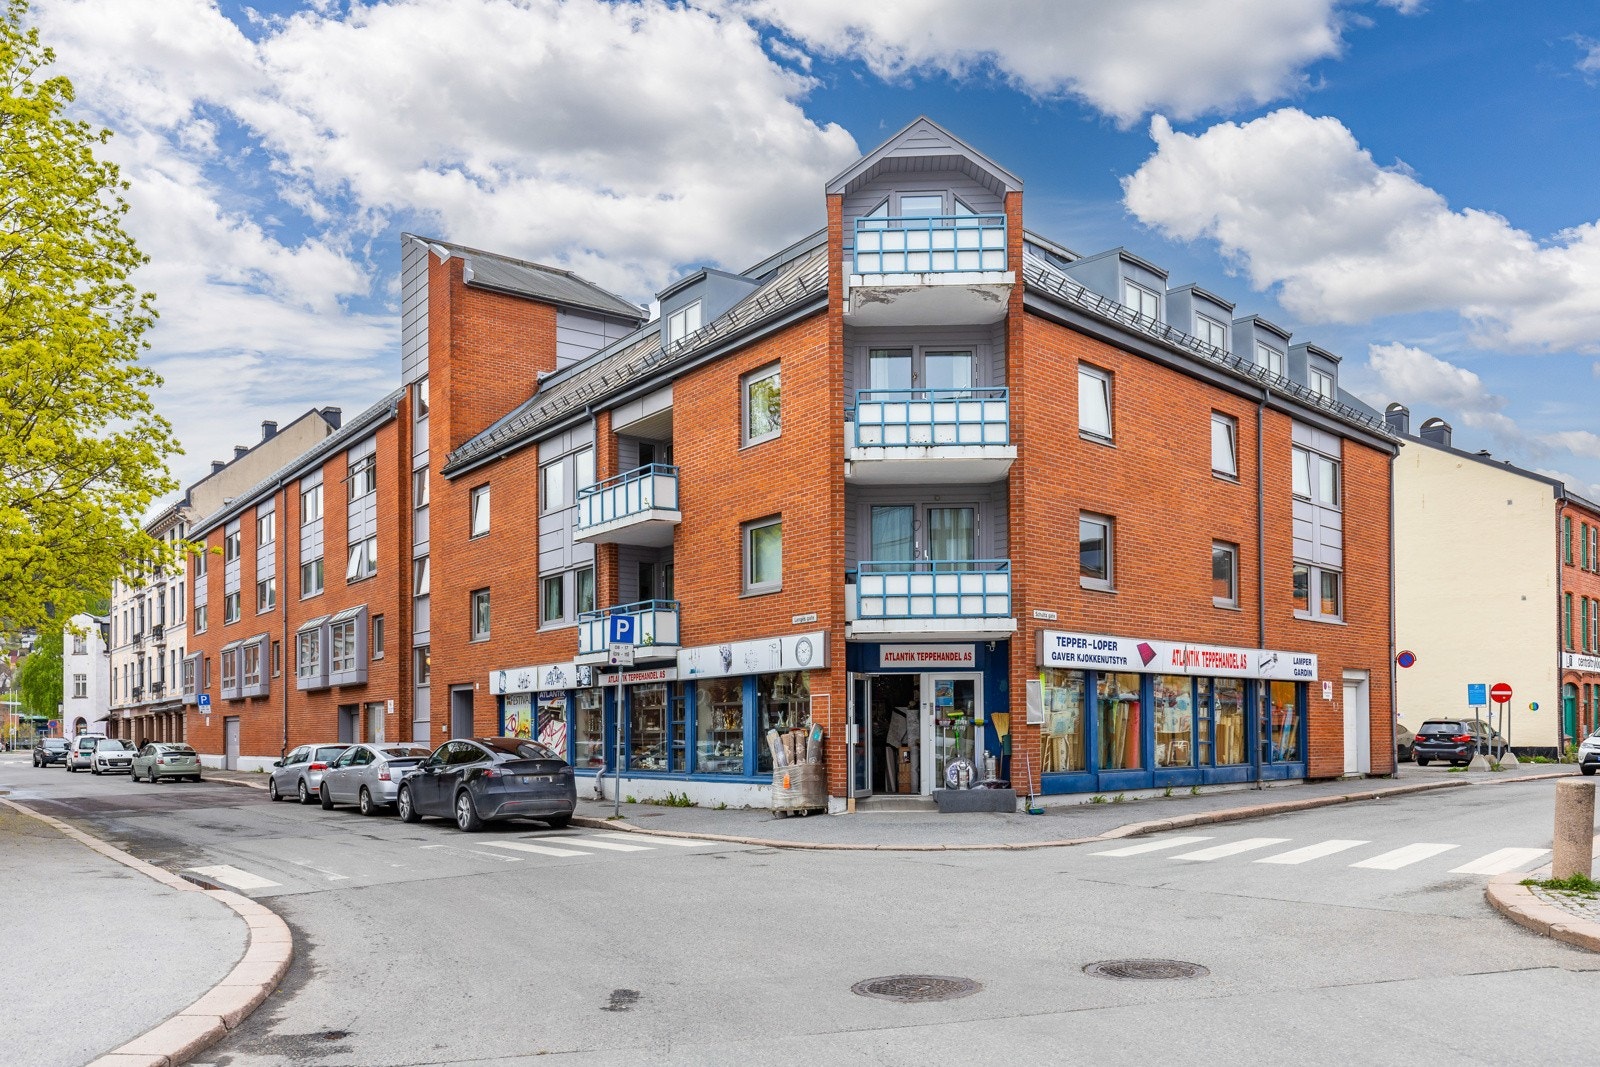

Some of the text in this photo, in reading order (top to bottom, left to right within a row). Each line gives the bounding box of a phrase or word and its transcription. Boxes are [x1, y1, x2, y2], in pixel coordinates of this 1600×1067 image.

[616, 619, 630, 640] P
[916, 652, 962, 661] TEPPEHANDEL
[963, 652, 972, 661] AS
[1051, 651, 1075, 662] GAVER
[1201, 651, 1239, 669] TEPPEHANDEL
[1239, 653, 1247, 670] AS
[1293, 657, 1312, 666] LAMPER
[608, 670, 665, 683] ATLATIK TEPPEHANDEL AS
[539, 690, 566, 698] ATLANTIK
[200, 695, 207, 704] P
